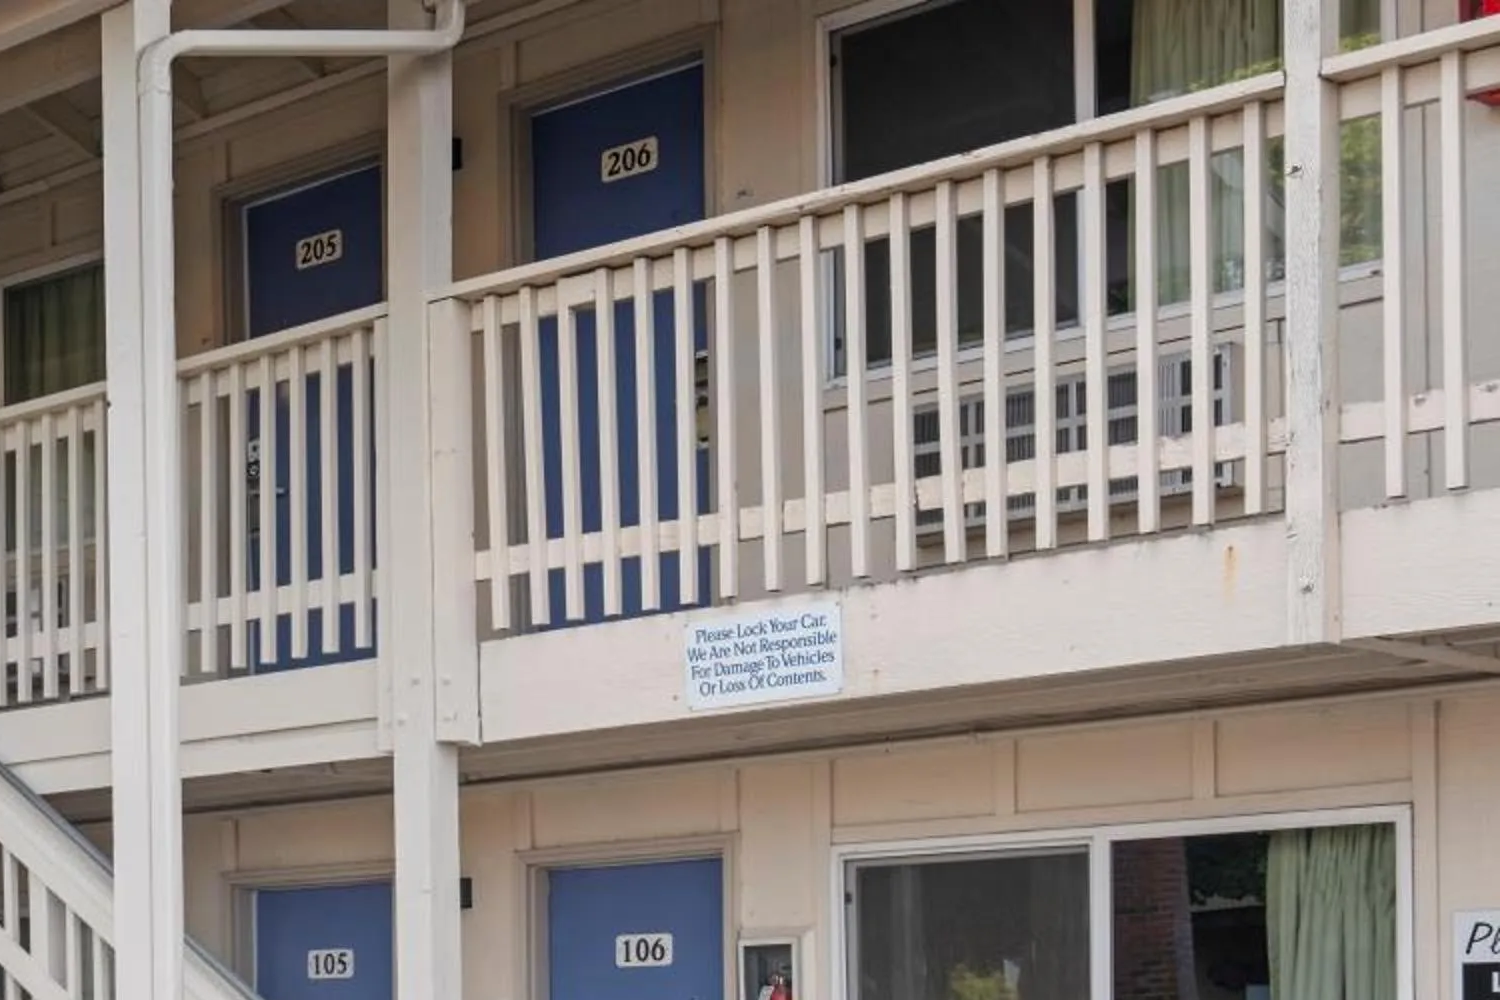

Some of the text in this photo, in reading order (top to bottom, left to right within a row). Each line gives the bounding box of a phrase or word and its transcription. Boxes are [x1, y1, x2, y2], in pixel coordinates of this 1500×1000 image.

[607, 142, 651, 178] 206
[300, 233, 337, 265] 205
[695, 628, 734, 644] Please
[737, 622, 768, 639] Lock
[769, 617, 798, 633] Your
[687, 630, 838, 662] We Are Not Responsible
[691, 649, 835, 681] For Damage To Vehicles
[700, 681, 718, 697] Or
[719, 679, 747, 695] Loss
[747, 674, 766, 691] Of
[312, 951, 349, 976] 105
[623, 937, 666, 964] 106
